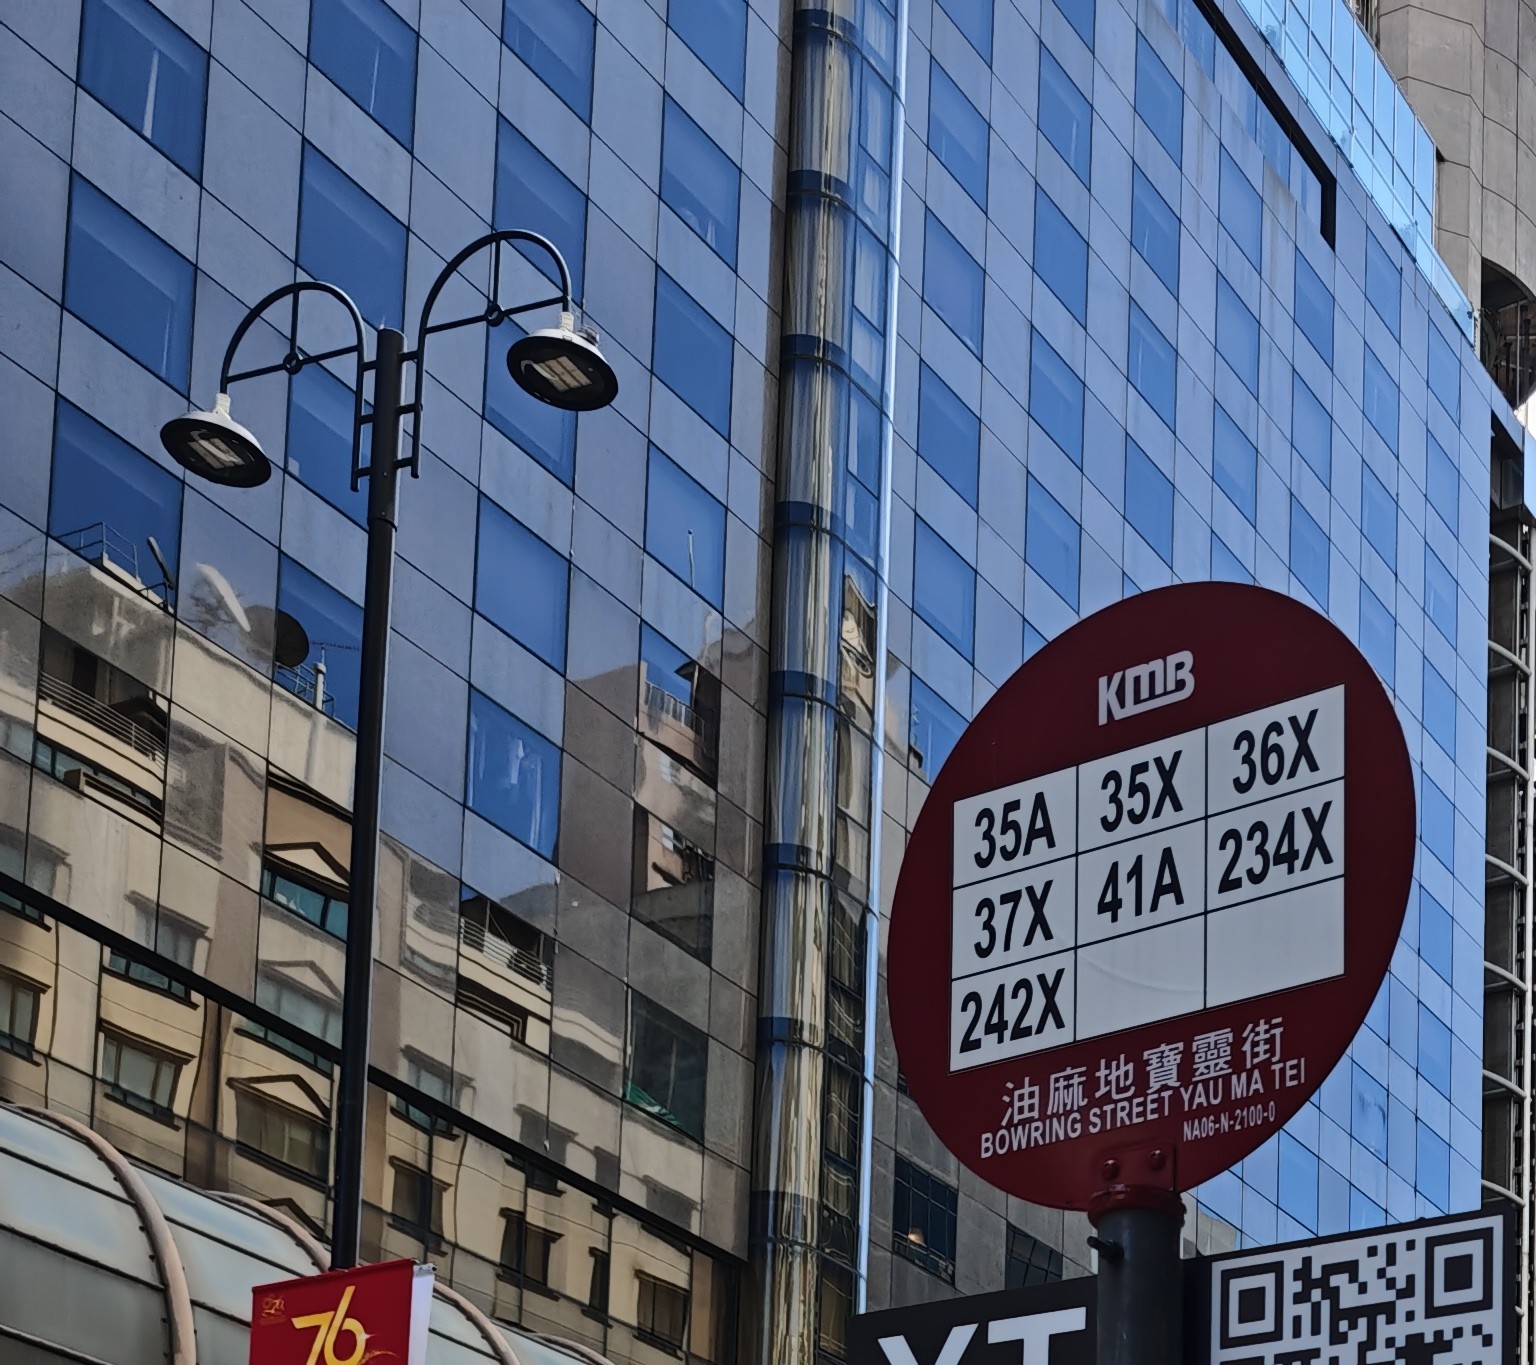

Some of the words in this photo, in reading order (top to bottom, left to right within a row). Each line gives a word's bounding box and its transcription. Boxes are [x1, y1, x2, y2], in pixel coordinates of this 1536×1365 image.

[1099, 650, 1195, 726] KMB
[973, 791, 1056, 869] 35A
[1100, 750, 1184, 832] 35X
[1231, 708, 1320, 794] 36X
[973, 879, 1054, 958] 37X
[1097, 846, 1184, 924] 41A
[1217, 801, 1334, 894] 234X
[959, 967, 1066, 1054] 242X
[980, 1109, 1083, 1160] BOWRING
[1088, 1092, 1174, 1136] STREET
[1181, 1075, 1224, 1112] YAU
[1230, 1067, 1264, 1102] MA
[1271, 1056, 1306, 1090] TEI
[1000, 1016, 1286, 1127] 油麻地寶靈街
[1183, 1100, 1277, 1143] NA06-N-2100-0
